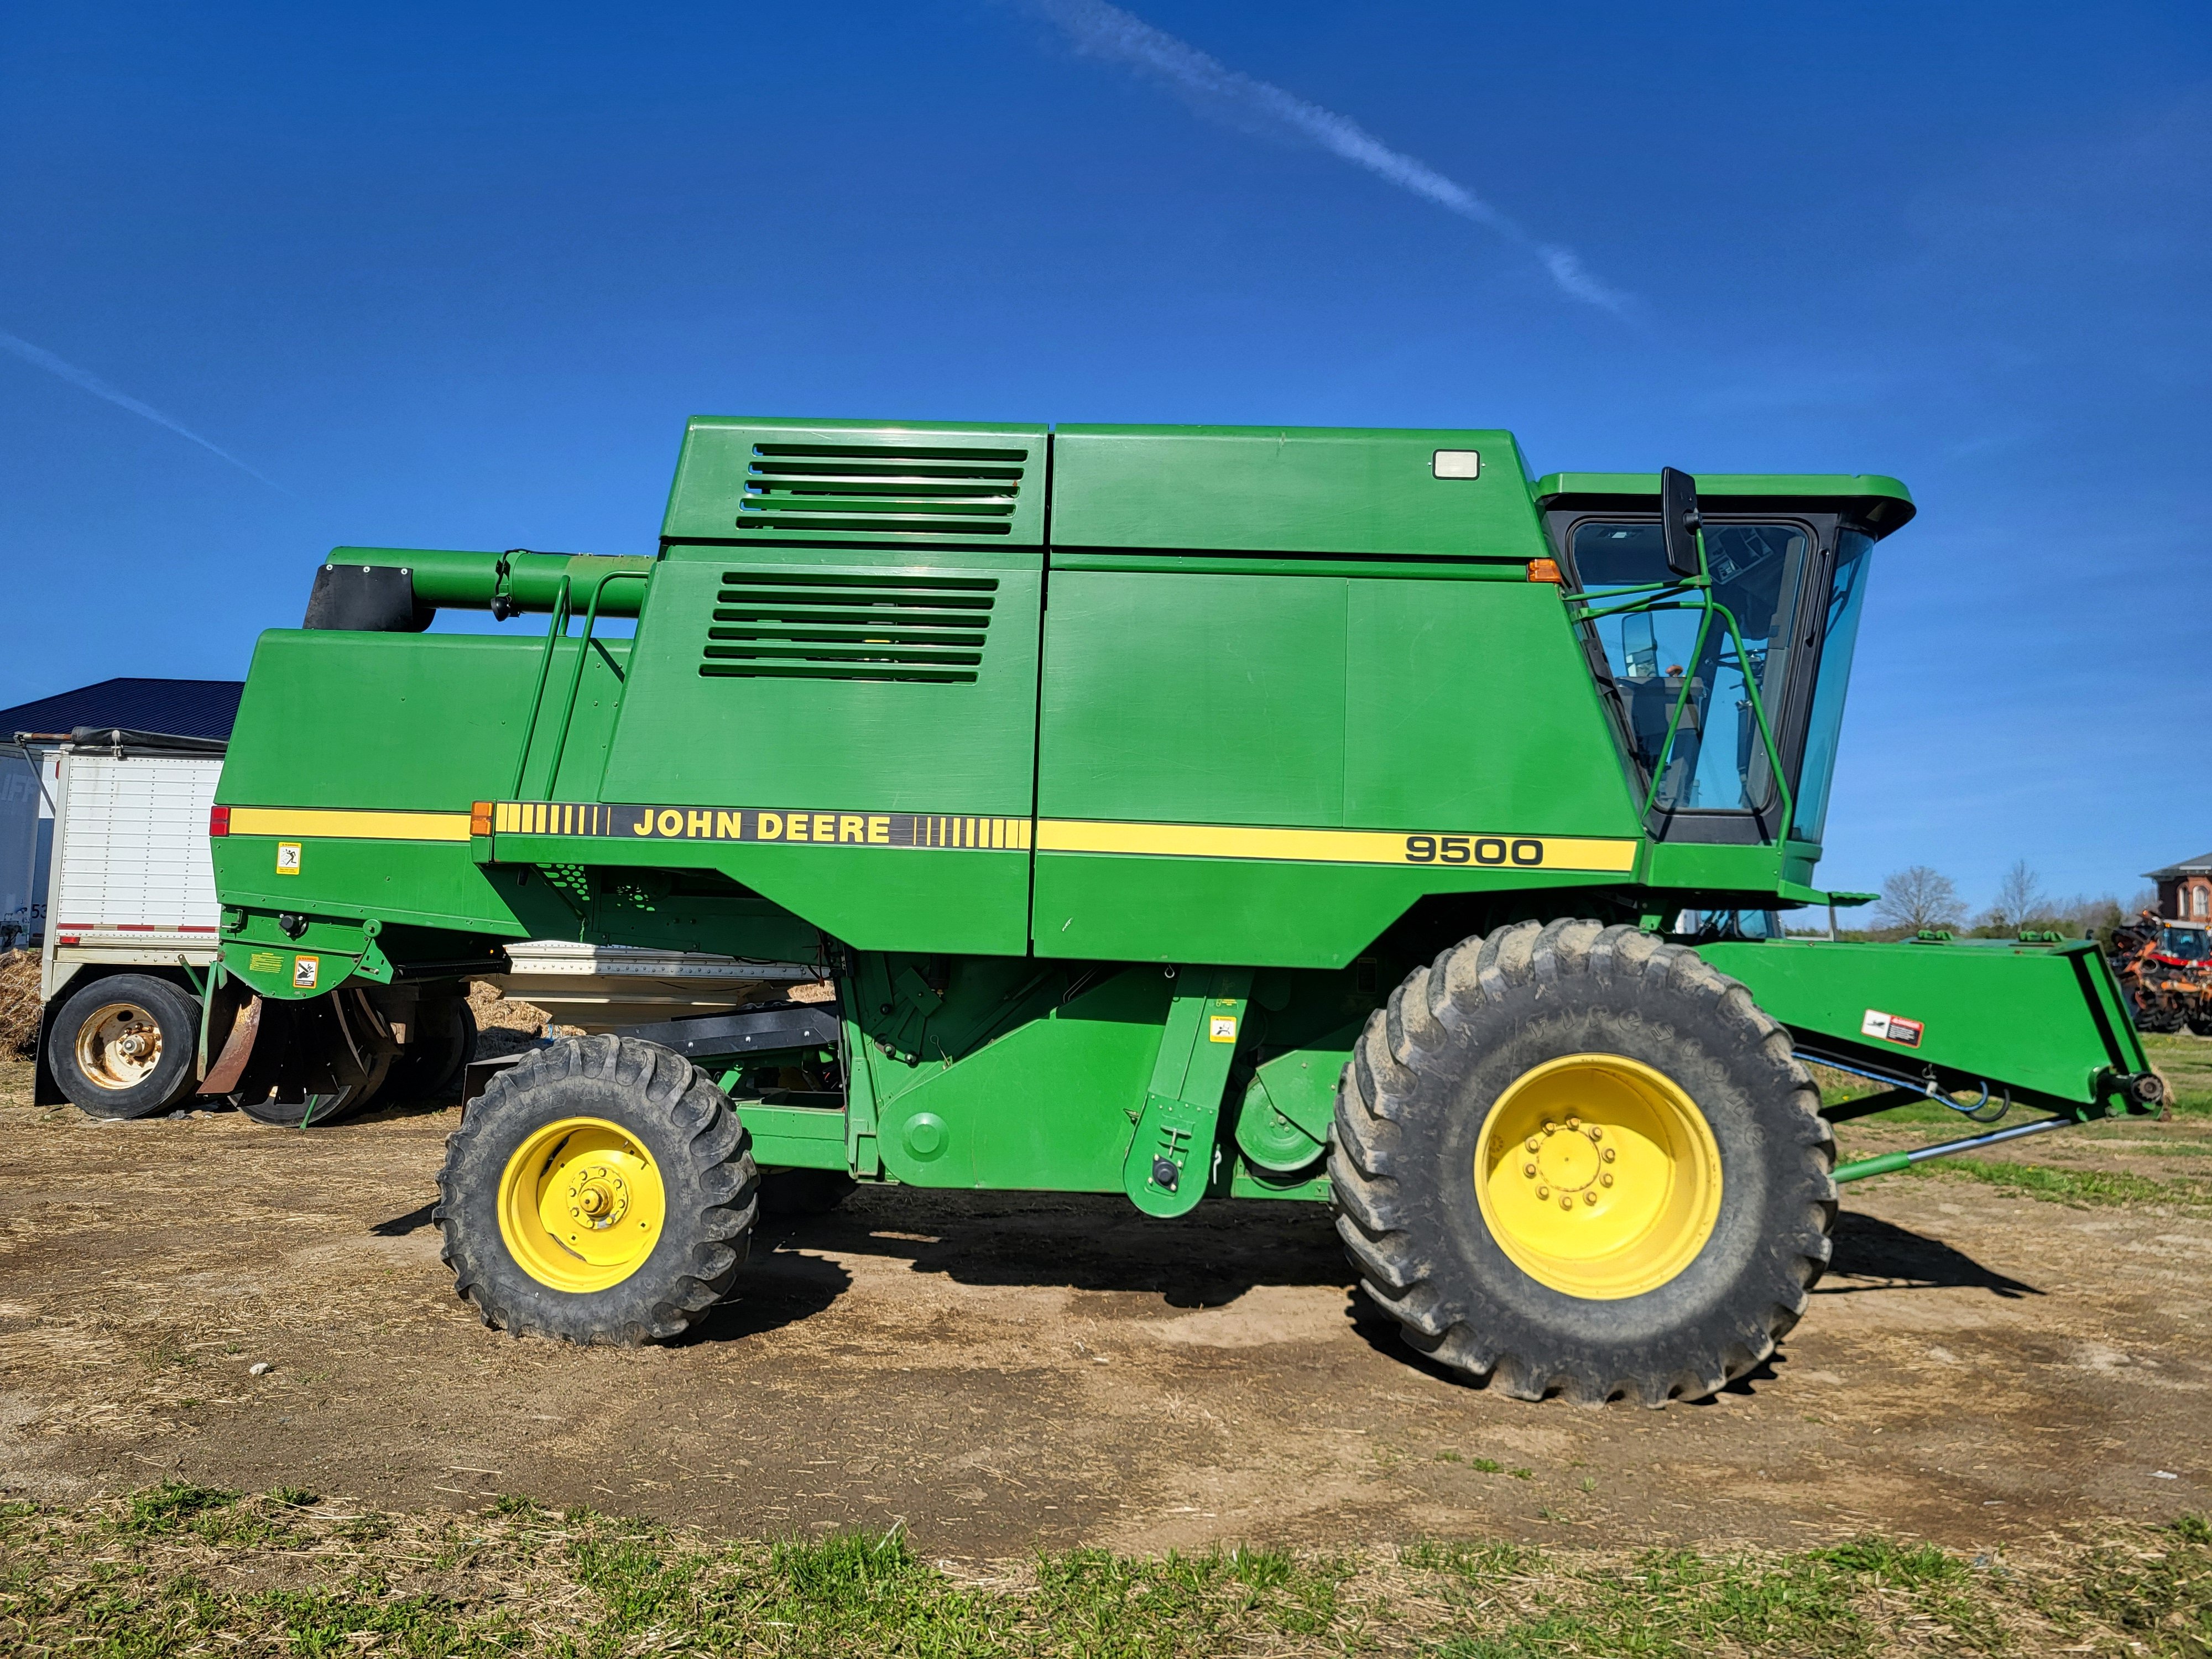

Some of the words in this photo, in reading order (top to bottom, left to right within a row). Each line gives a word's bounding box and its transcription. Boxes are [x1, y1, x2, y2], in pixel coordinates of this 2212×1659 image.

[633, 809, 742, 839] JOHN
[757, 813, 890, 843] DEERE
[1405, 836, 1543, 865] 9500
